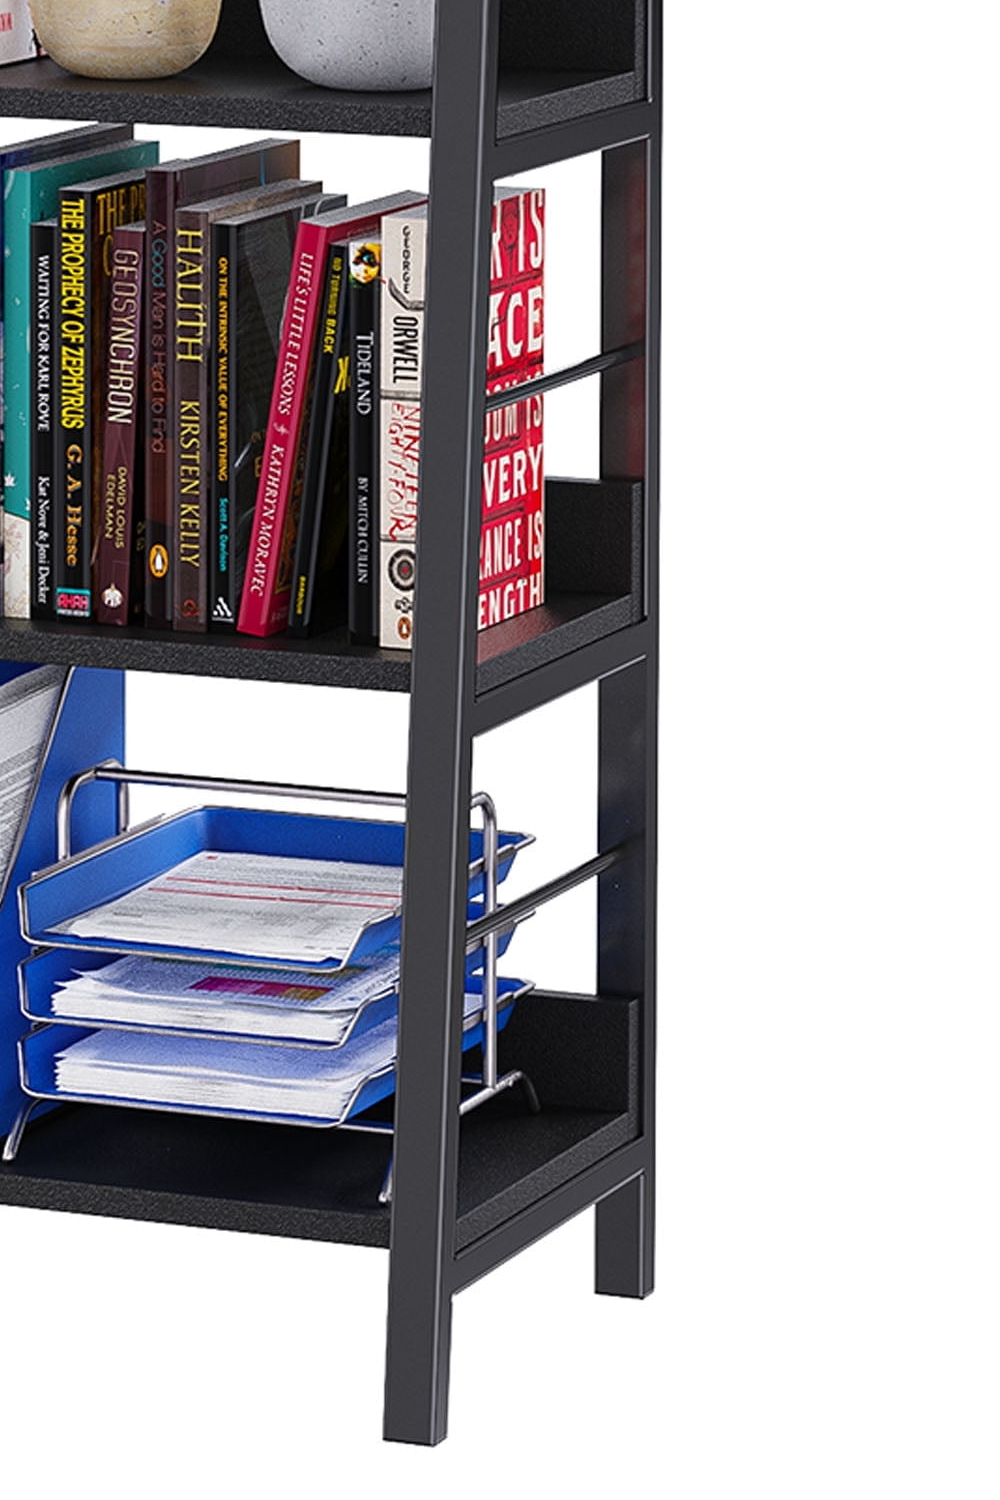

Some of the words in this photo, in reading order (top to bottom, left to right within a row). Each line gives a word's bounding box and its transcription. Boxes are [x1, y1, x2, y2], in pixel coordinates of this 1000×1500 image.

[61, 198, 85, 231] THE
[152, 220, 165, 235] A
[517, 189, 544, 272] IS
[61, 233, 84, 318] PROPHECY
[151, 238, 167, 289] Good
[218, 257, 228, 274] ON
[296, 252, 315, 295] LIFE'S
[402, 225, 412, 294] GEORGE
[36, 255, 49, 320] WAITING
[218, 277, 228, 297] THE
[151, 291, 166, 331] Man
[218, 300, 228, 354] INTRINSIC
[287, 297, 308, 349] LITTLE
[36, 322, 49, 352] FOR
[61, 320, 83, 344] OF
[106, 249, 139, 424] GEOSYNCHRON
[322, 318, 337, 354] BACK
[391, 314, 419, 384] ORWELL
[36, 355, 49, 389] KARL
[61, 346, 83, 429] ZEPHYRUS
[151, 353, 167, 393] Hard
[218, 357, 228, 392] VALUE
[277, 351, 299, 416] LESSONS
[356, 332, 374, 416] TIDELAND
[36, 392, 49, 432] ROVE
[151, 396, 166, 414] to
[218, 394, 228, 408] OF
[151, 418, 167, 452] Find
[180, 400, 200, 495] KIRSTEN
[218, 410, 228, 482] EVERYTHING
[65, 444, 82, 471] G.
[36, 476, 49, 496] Kat
[65, 475, 82, 500] A.
[116, 466, 128, 506] DAVID
[260, 443, 285, 520] KATHRYN
[356, 477, 369, 493] BY
[36, 499, 49, 527] Nove
[104, 473, 117, 539] EDELMAN
[218, 497, 228, 522] Scott
[36, 530, 49, 540] &
[65, 505, 82, 567] Hesse
[114, 509, 126, 549] LOUIS
[180, 503, 200, 568] KELLY
[527, 510, 543, 562] IS
[249, 521, 273, 597] MORAVEC
[36, 566, 49, 604] Decker
